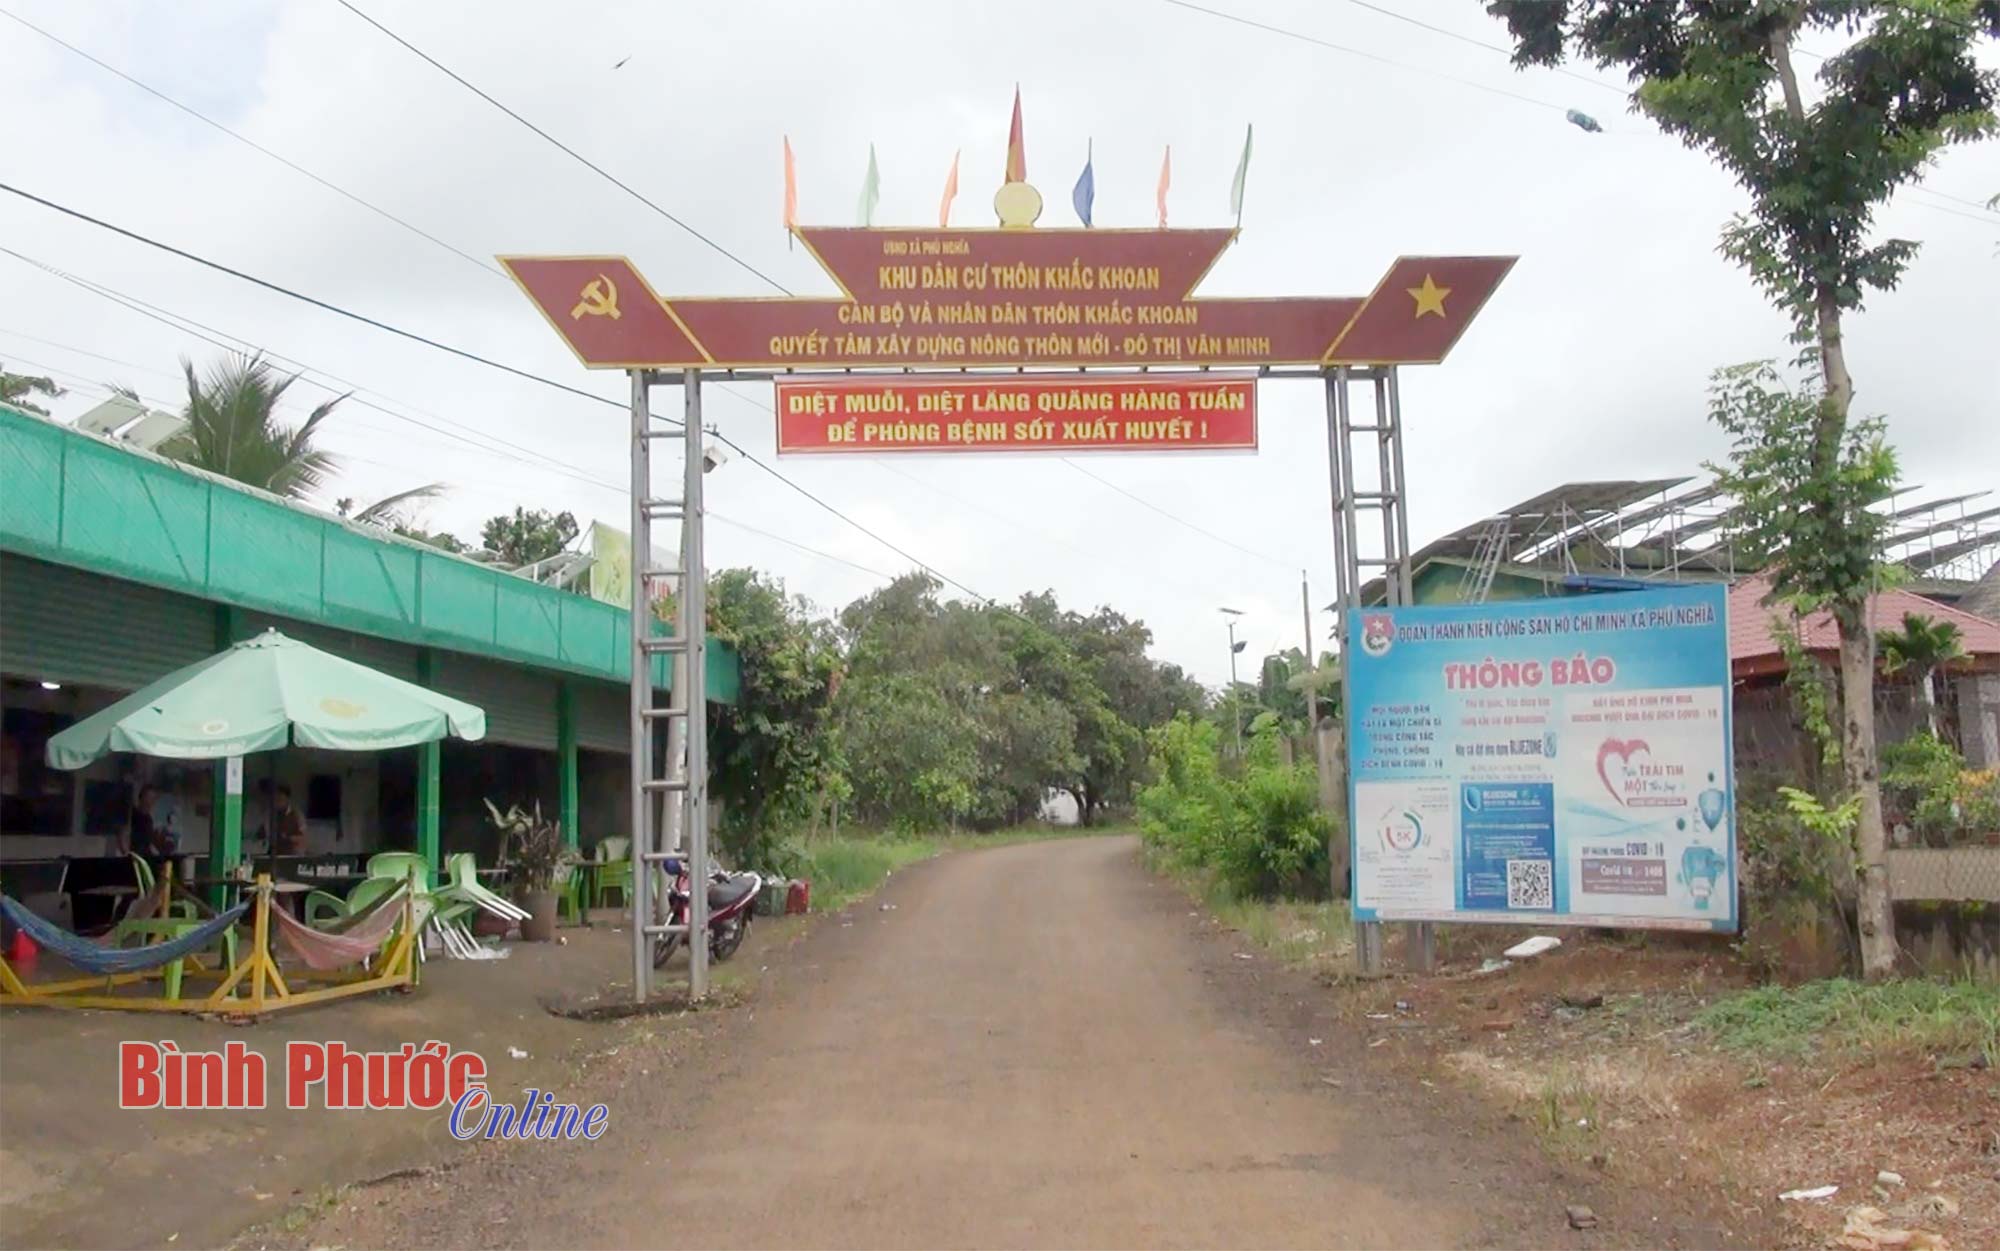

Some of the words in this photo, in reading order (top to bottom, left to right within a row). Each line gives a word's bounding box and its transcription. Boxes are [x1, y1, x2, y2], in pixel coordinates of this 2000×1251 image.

[879, 266, 916, 289] KHU
[922, 261, 957, 289] DÂN
[963, 263, 989, 289] CƯ
[991, 261, 1039, 289] THÔN
[1045, 257, 1094, 289] KHẮC
[1099, 266, 1160, 289] KHOAN
[880, 301, 904, 328] BỘ
[909, 301, 933, 324] VÀ
[937, 301, 987, 324] NHÂN
[991, 301, 1027, 324] DÂN
[1033, 301, 1080, 324] THÔN
[1085, 299, 1133, 324] KHẮC
[1137, 306, 1198, 324] KHOAN
[770, 328, 828, 356] QUYẾT
[834, 332, 872, 355] TÂM
[876, 332, 912, 355] XÂY
[917, 334, 965, 360] DỰNG
[970, 332, 1019, 356] NÔNG
[1025, 332, 1072, 355] THÔN
[1077, 331, 1109, 355] MỚI
[1123, 333, 1148, 355] ĐÔ
[1153, 337, 1181, 360] THỊ
[1187, 333, 1221, 355] VĂN
[1226, 337, 1270, 355] MINH
[789, 391, 838, 417] DIỆT
[845, 389, 911, 414] MUỖI,
[917, 390, 965, 416] DIỆT
[972, 389, 1031, 412] LĂNG
[1038, 389, 1113, 413] QUĂNG
[1121, 388, 1181, 411] HÀNG
[827, 416, 858, 443] ĐỂ
[864, 420, 940, 442] PHÒNG
[947, 419, 1007, 444] BỆNH
[1014, 417, 1055, 441] SỐT
[1062, 416, 1119, 440] XUẤT
[1125, 416, 1193, 440] HUYẾT
[1200, 420, 1208, 439] !
[1596, 613, 1627, 630] MINH
[1445, 656, 1544, 690] THÔNG
[1551, 652, 1616, 685] BÁO
